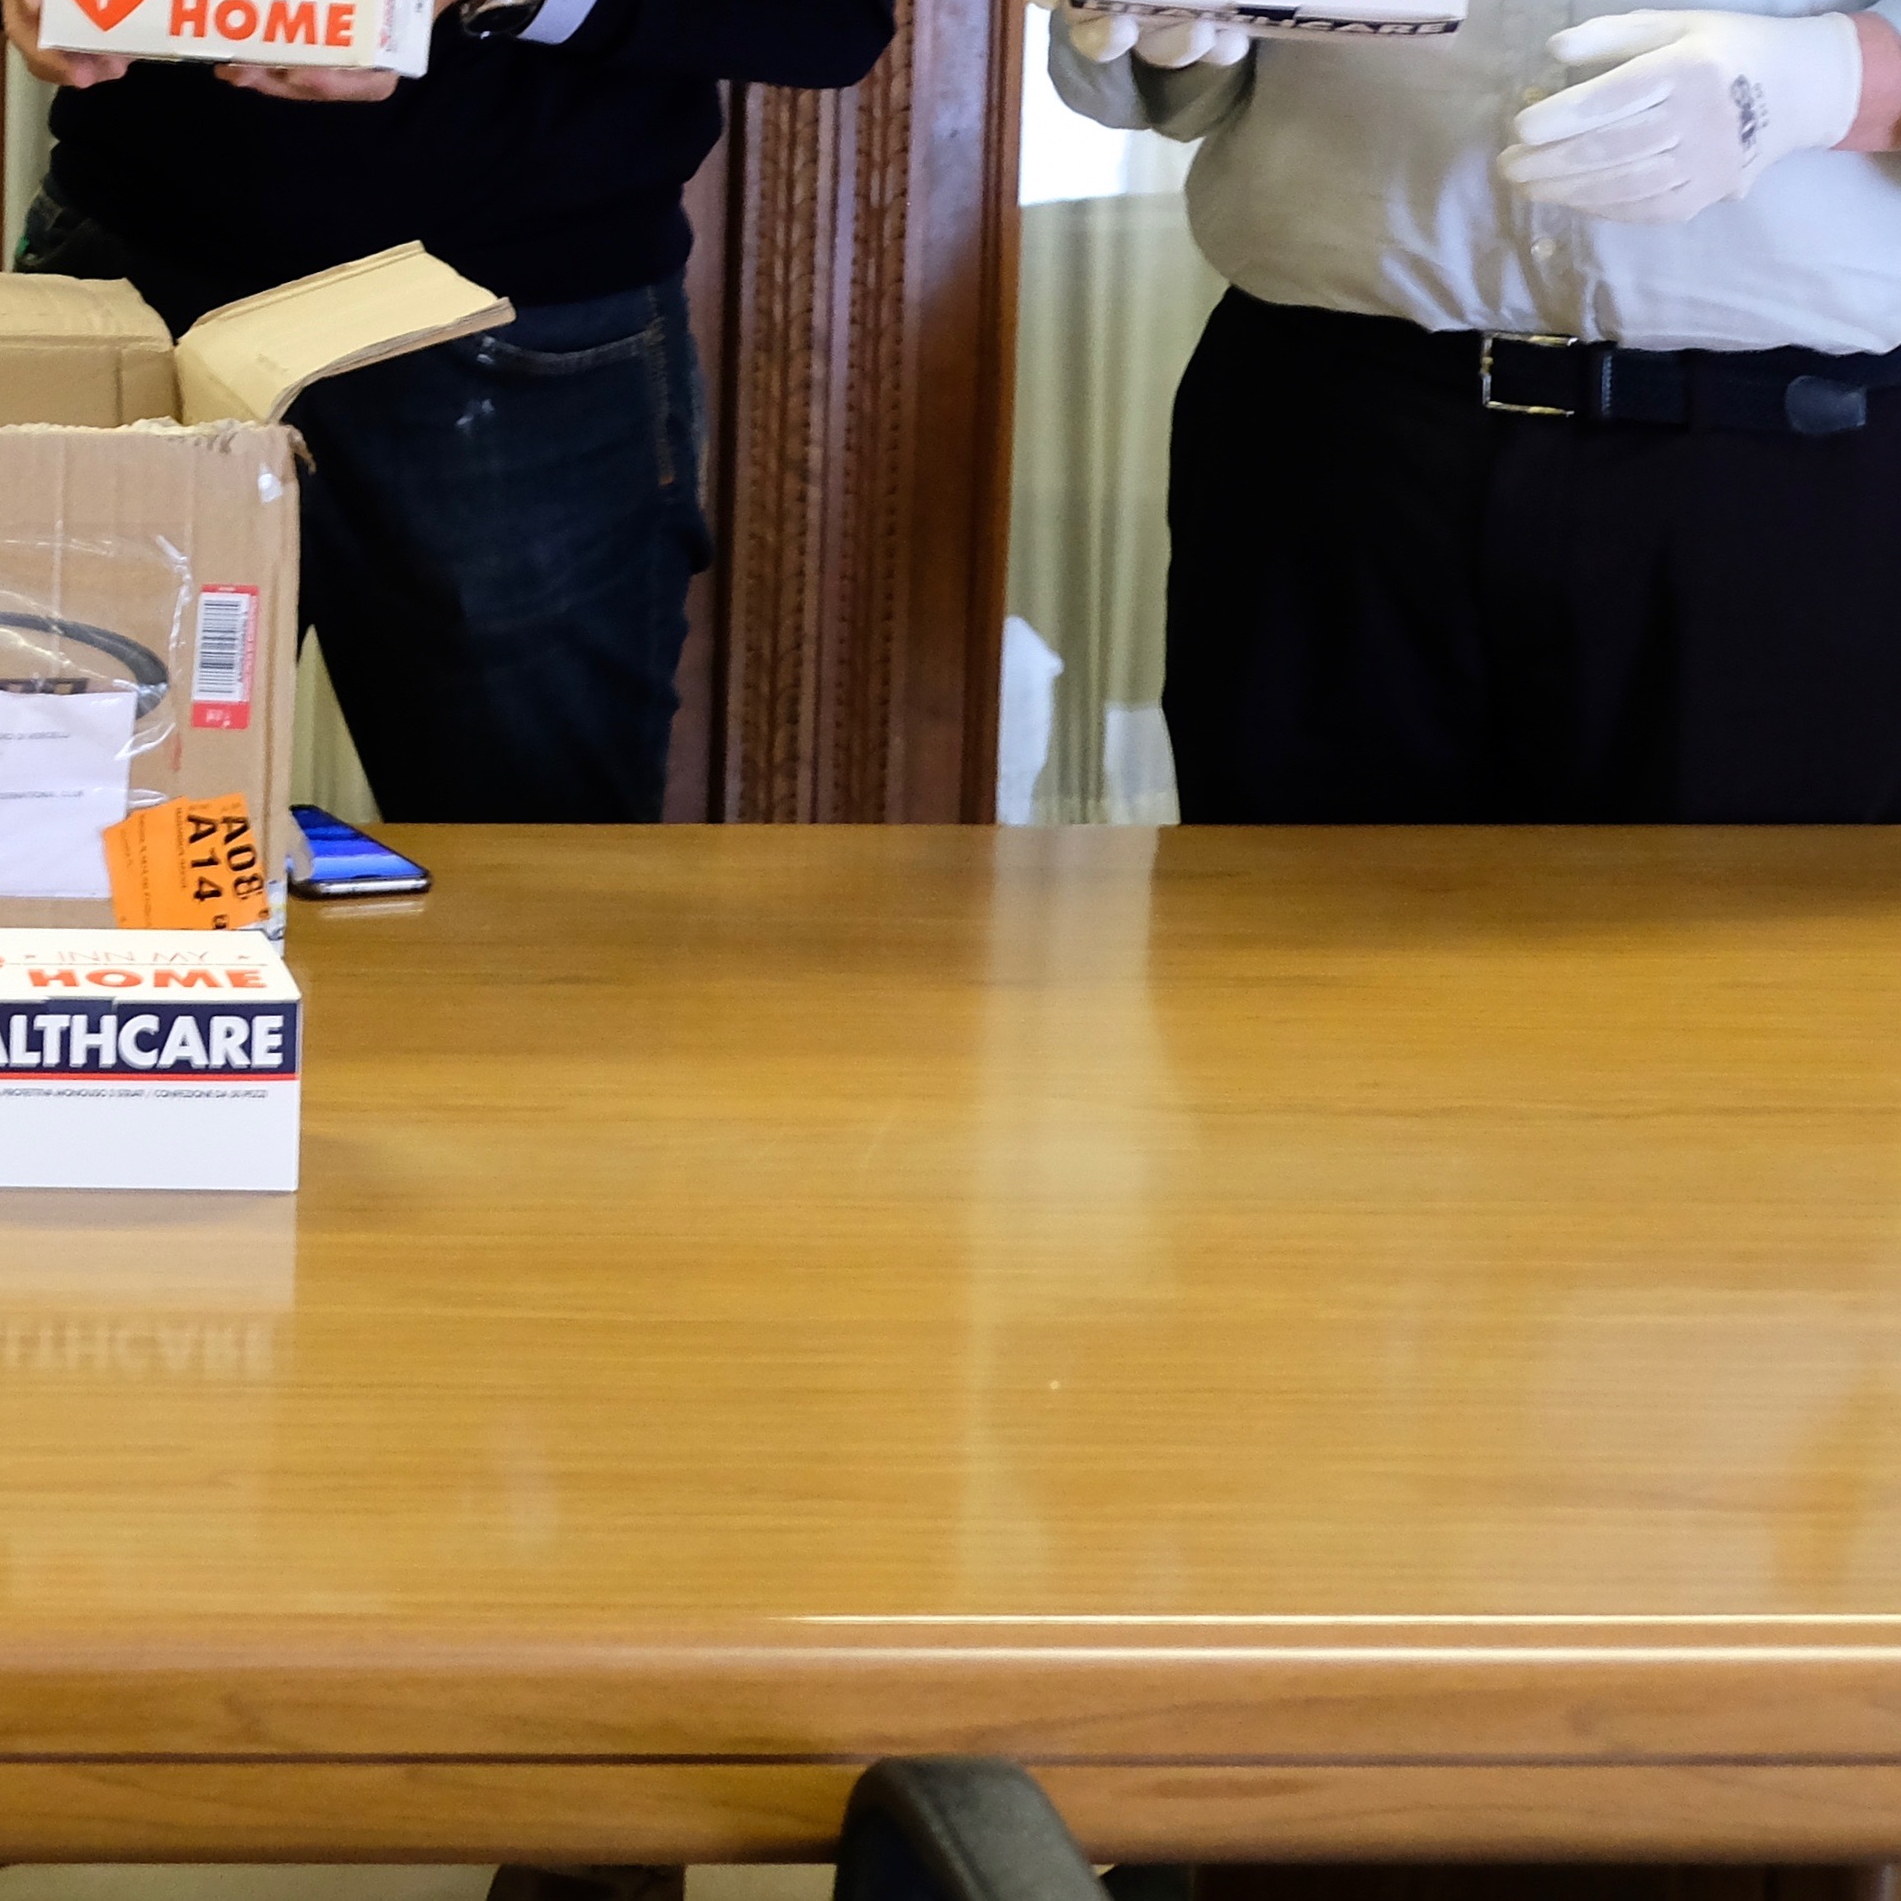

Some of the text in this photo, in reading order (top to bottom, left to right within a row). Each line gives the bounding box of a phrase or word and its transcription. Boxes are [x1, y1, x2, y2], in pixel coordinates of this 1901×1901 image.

[58, 950, 209, 963] INN MY
[27, 968, 268, 989] HOME
